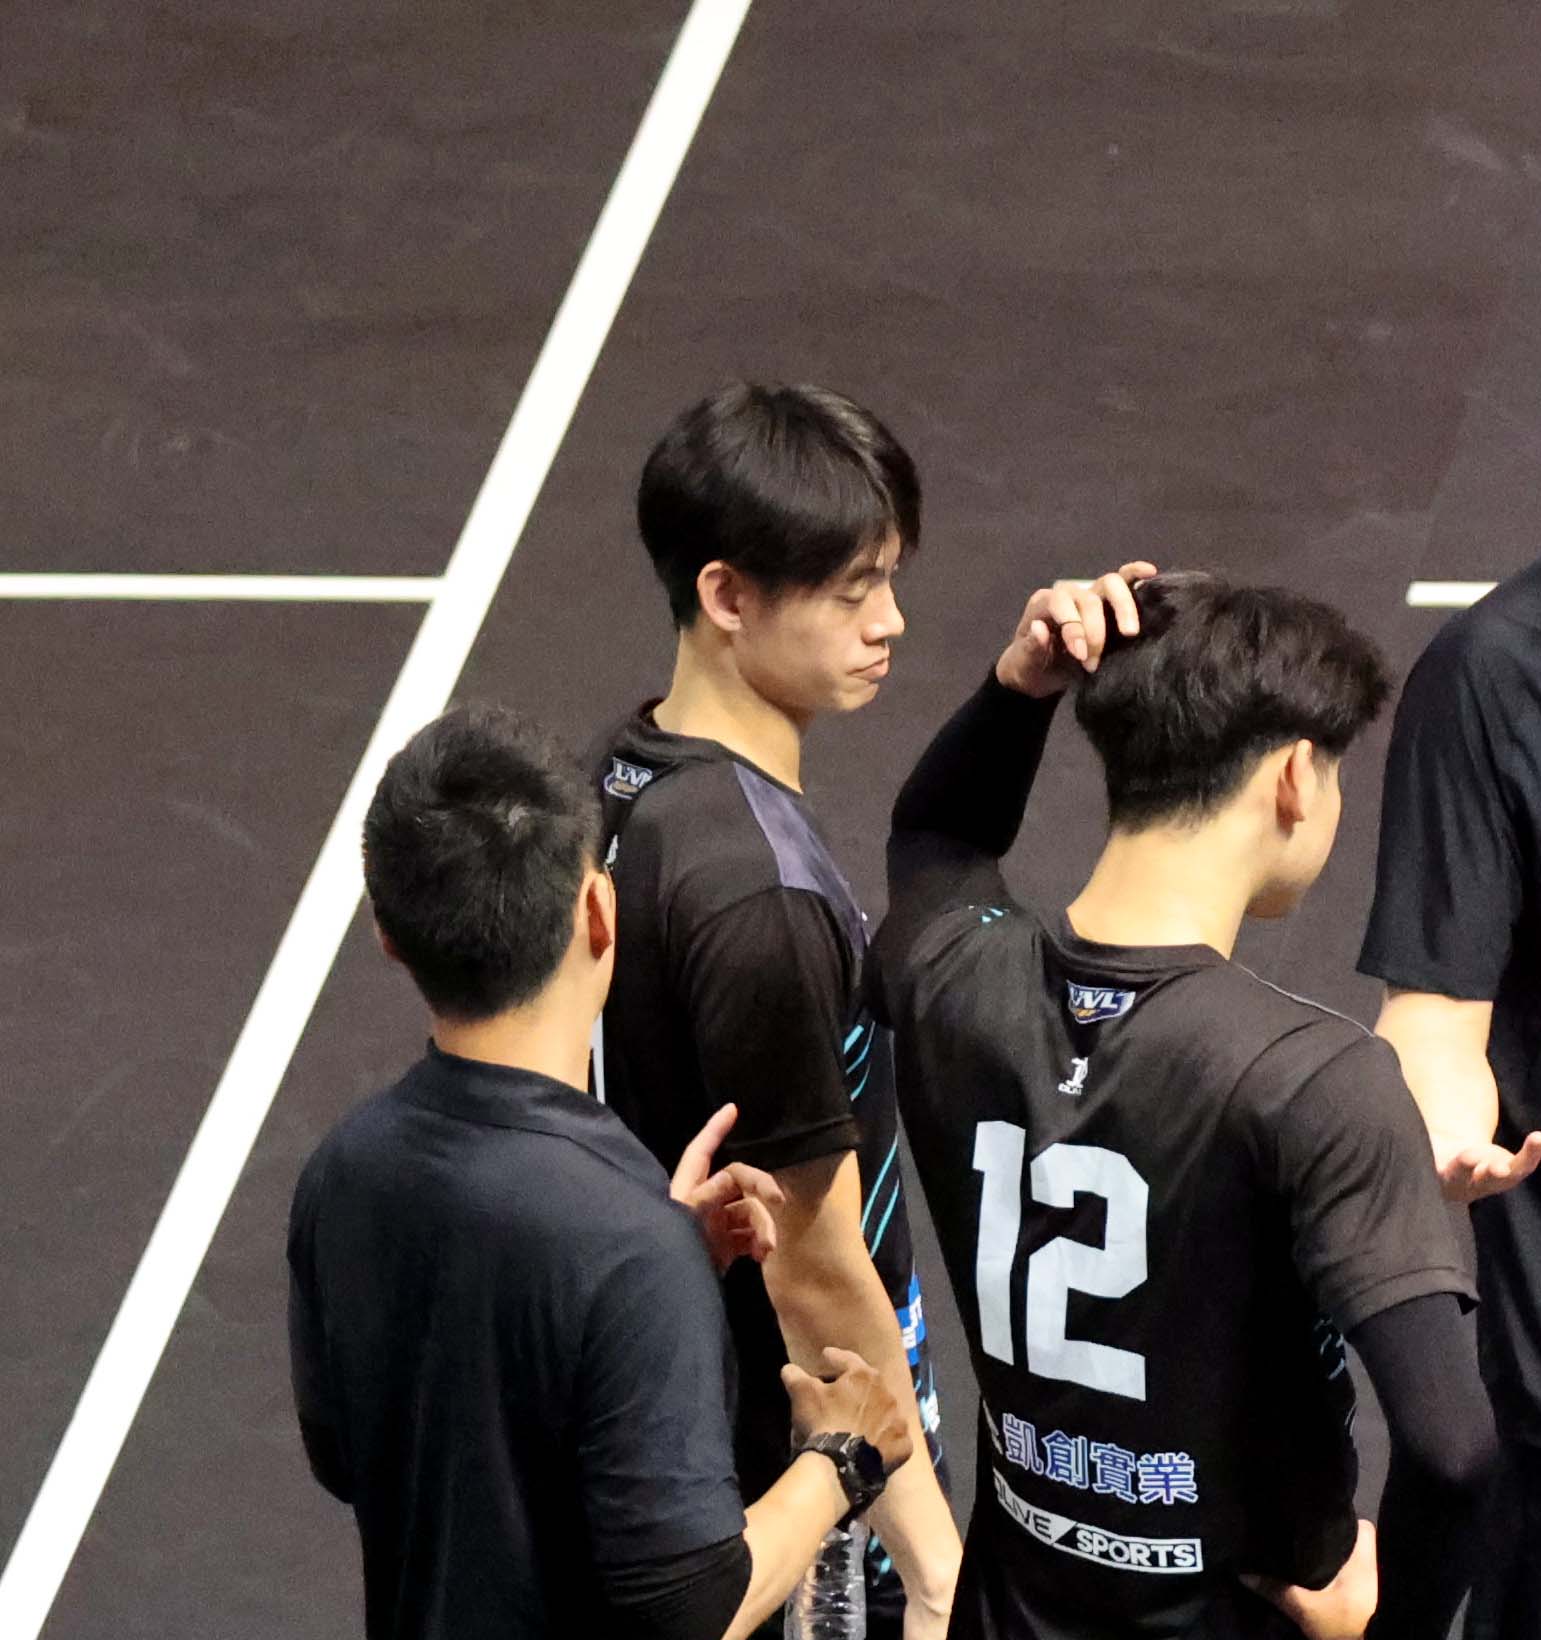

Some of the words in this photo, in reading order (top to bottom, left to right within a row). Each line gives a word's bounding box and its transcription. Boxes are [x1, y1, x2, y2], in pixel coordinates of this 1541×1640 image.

[972, 1120, 1149, 1401] 12
[1002, 1413, 1199, 1504] 凱創實業
[1075, 1528, 1196, 1567] SPORTS
